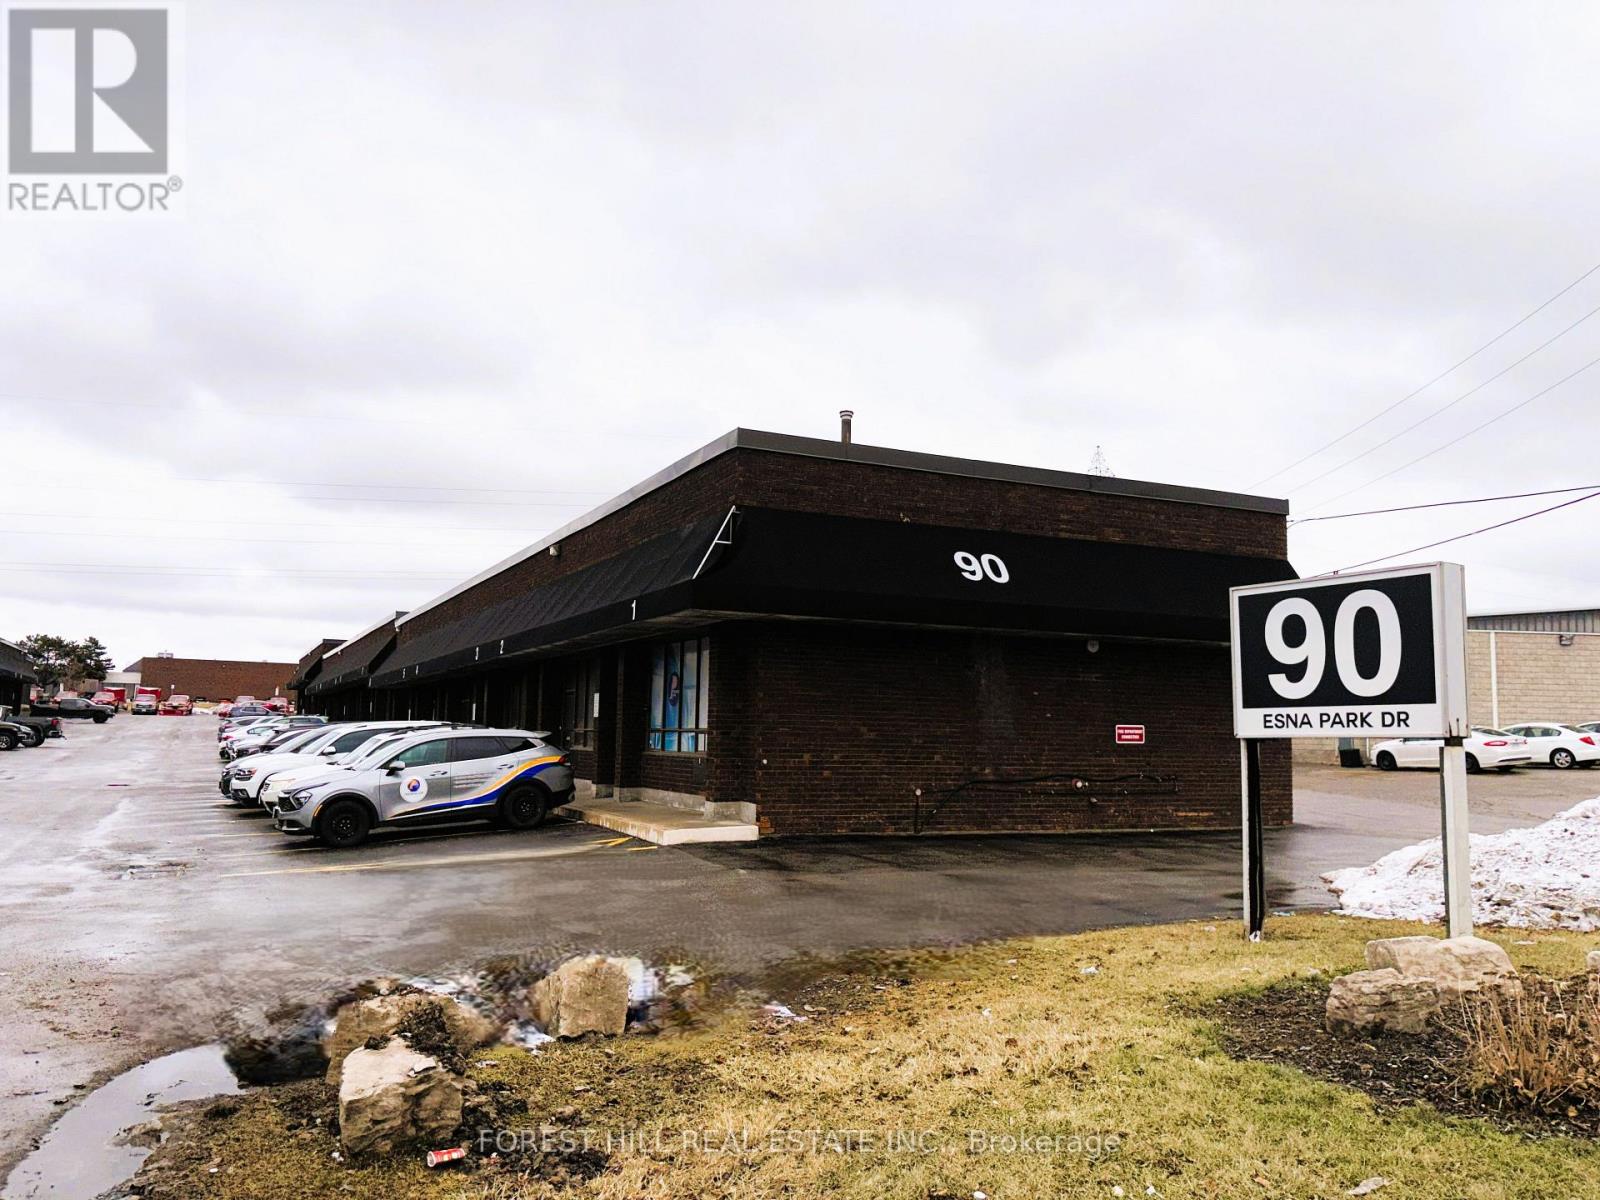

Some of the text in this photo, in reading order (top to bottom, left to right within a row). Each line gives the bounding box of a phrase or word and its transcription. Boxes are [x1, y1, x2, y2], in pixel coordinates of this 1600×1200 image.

[953, 551, 1010, 584] 90
[1264, 589, 1402, 700] 90
[1263, 710, 1410, 729] ESNA PARK DR
